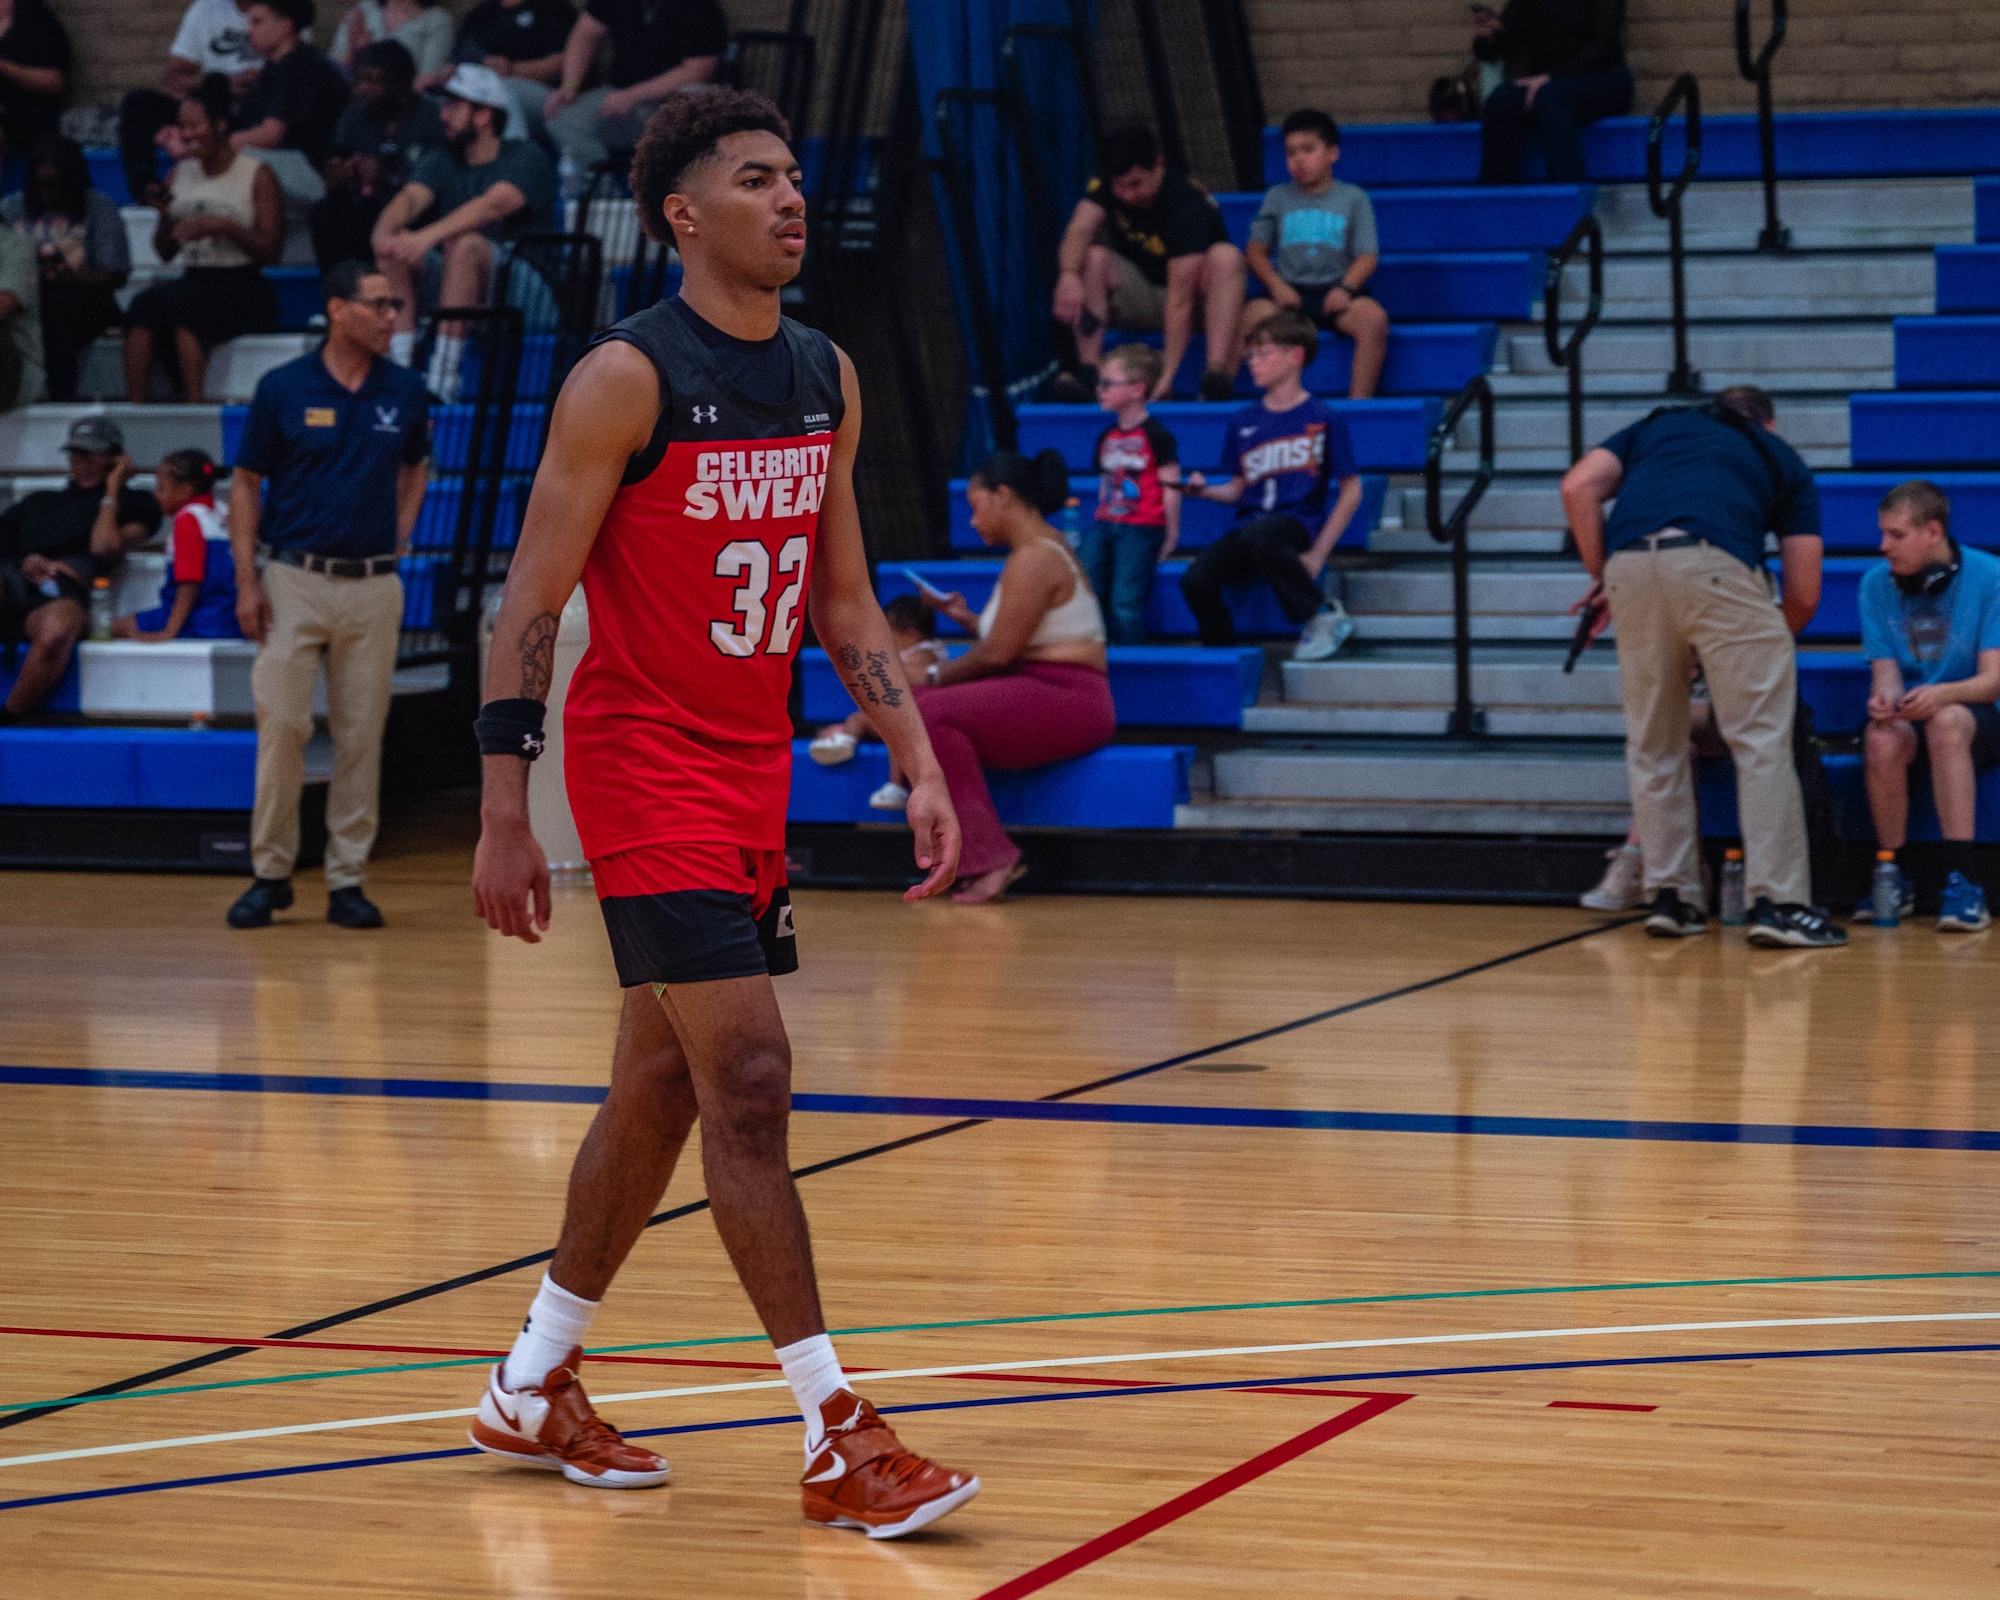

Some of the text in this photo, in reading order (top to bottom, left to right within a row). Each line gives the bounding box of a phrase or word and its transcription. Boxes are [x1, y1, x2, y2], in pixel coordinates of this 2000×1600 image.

[696, 443, 831, 482] CELEBRITY
[709, 535, 809, 658] 32
[857, 673, 880, 706] over
